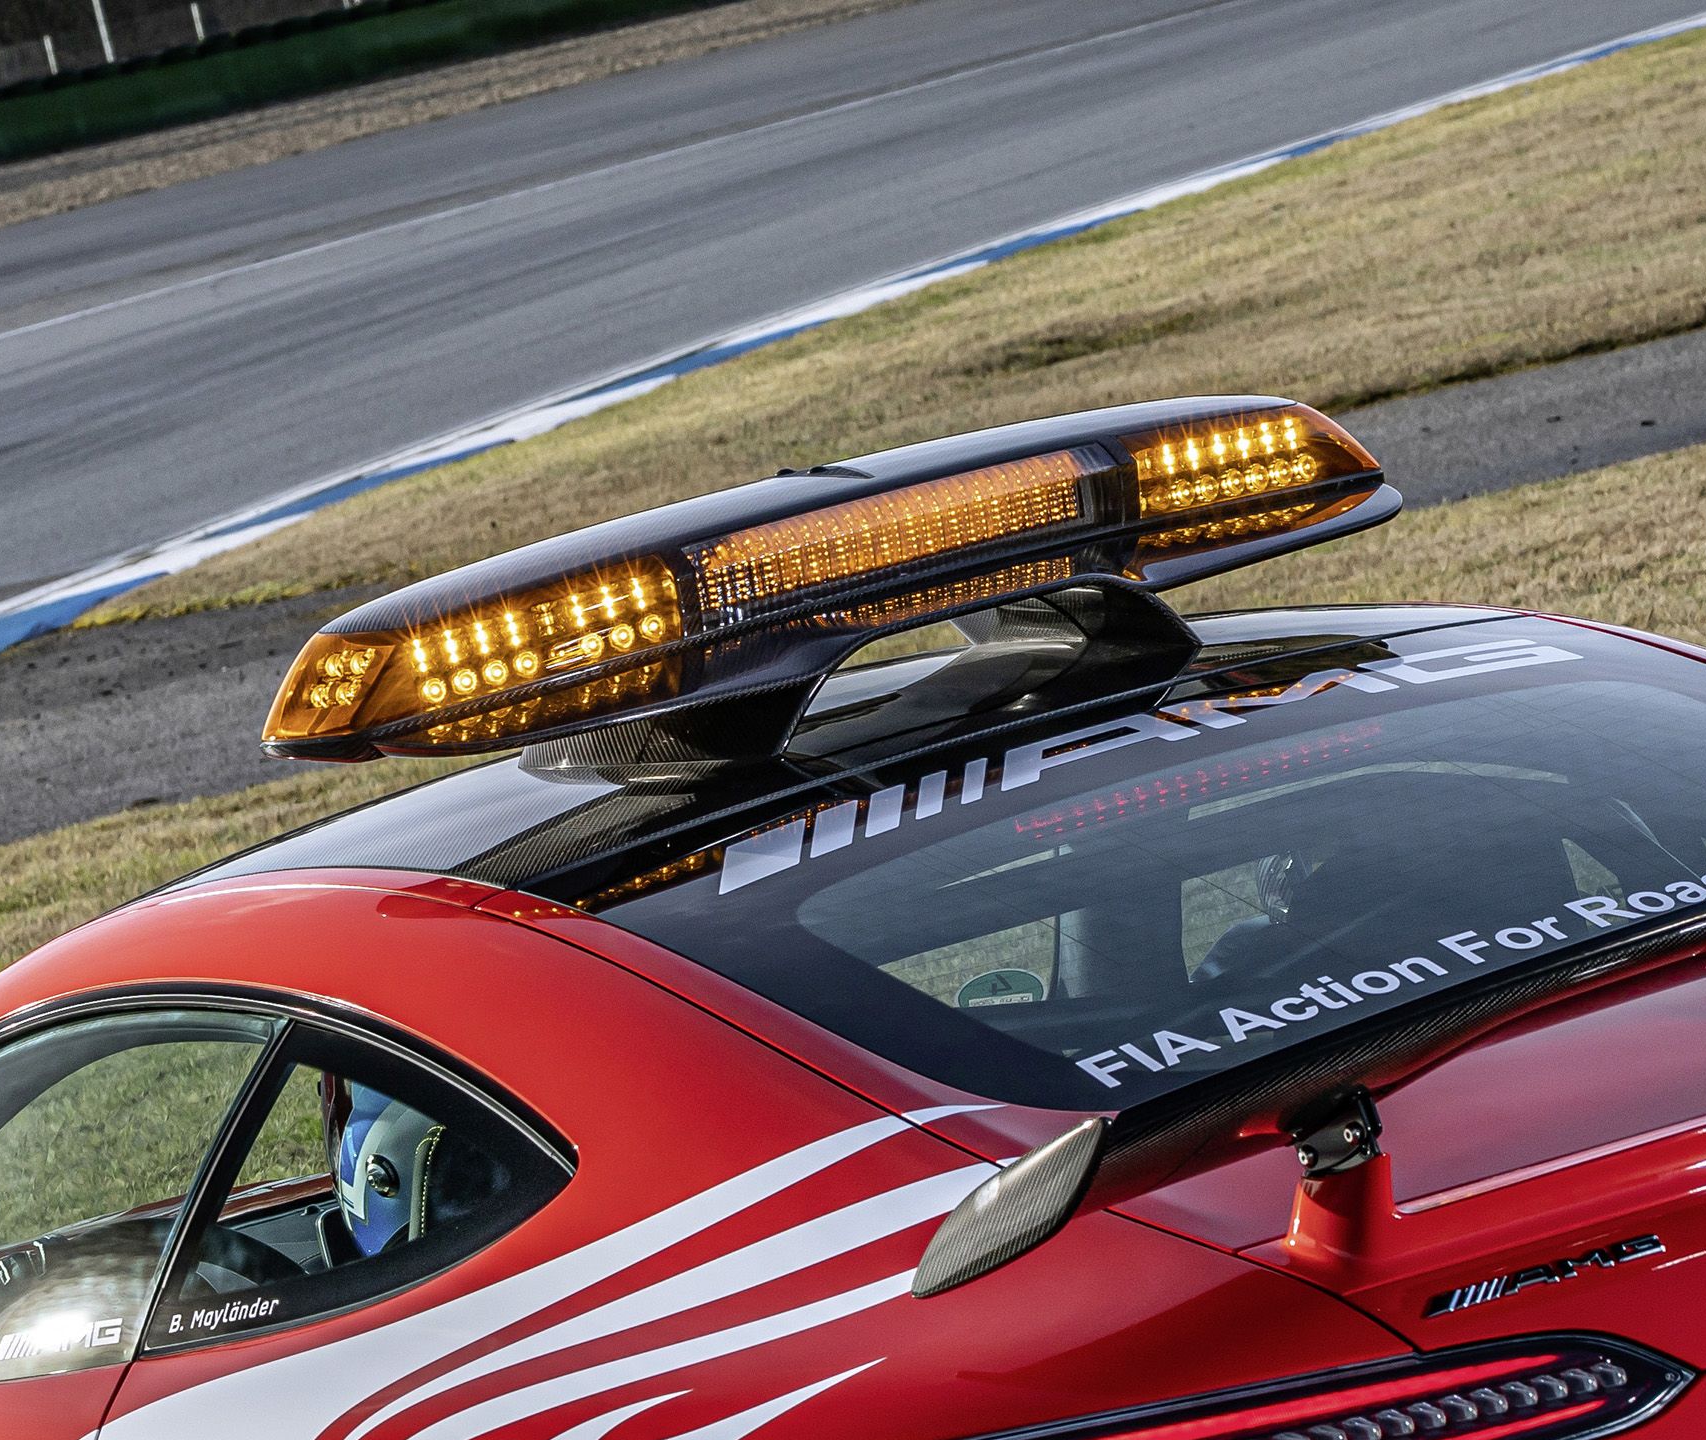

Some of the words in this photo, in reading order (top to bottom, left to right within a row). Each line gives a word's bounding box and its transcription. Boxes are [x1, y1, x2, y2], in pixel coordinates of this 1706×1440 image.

[1001, 638, 1583, 791] AMG
[1076, 1015, 1220, 1089] FIA
[1228, 955, 1449, 1042] Action
[1438, 914, 1567, 965] For
[168, 1314, 185, 1334] B.
[190, 1296, 280, 1330] Mayländer
